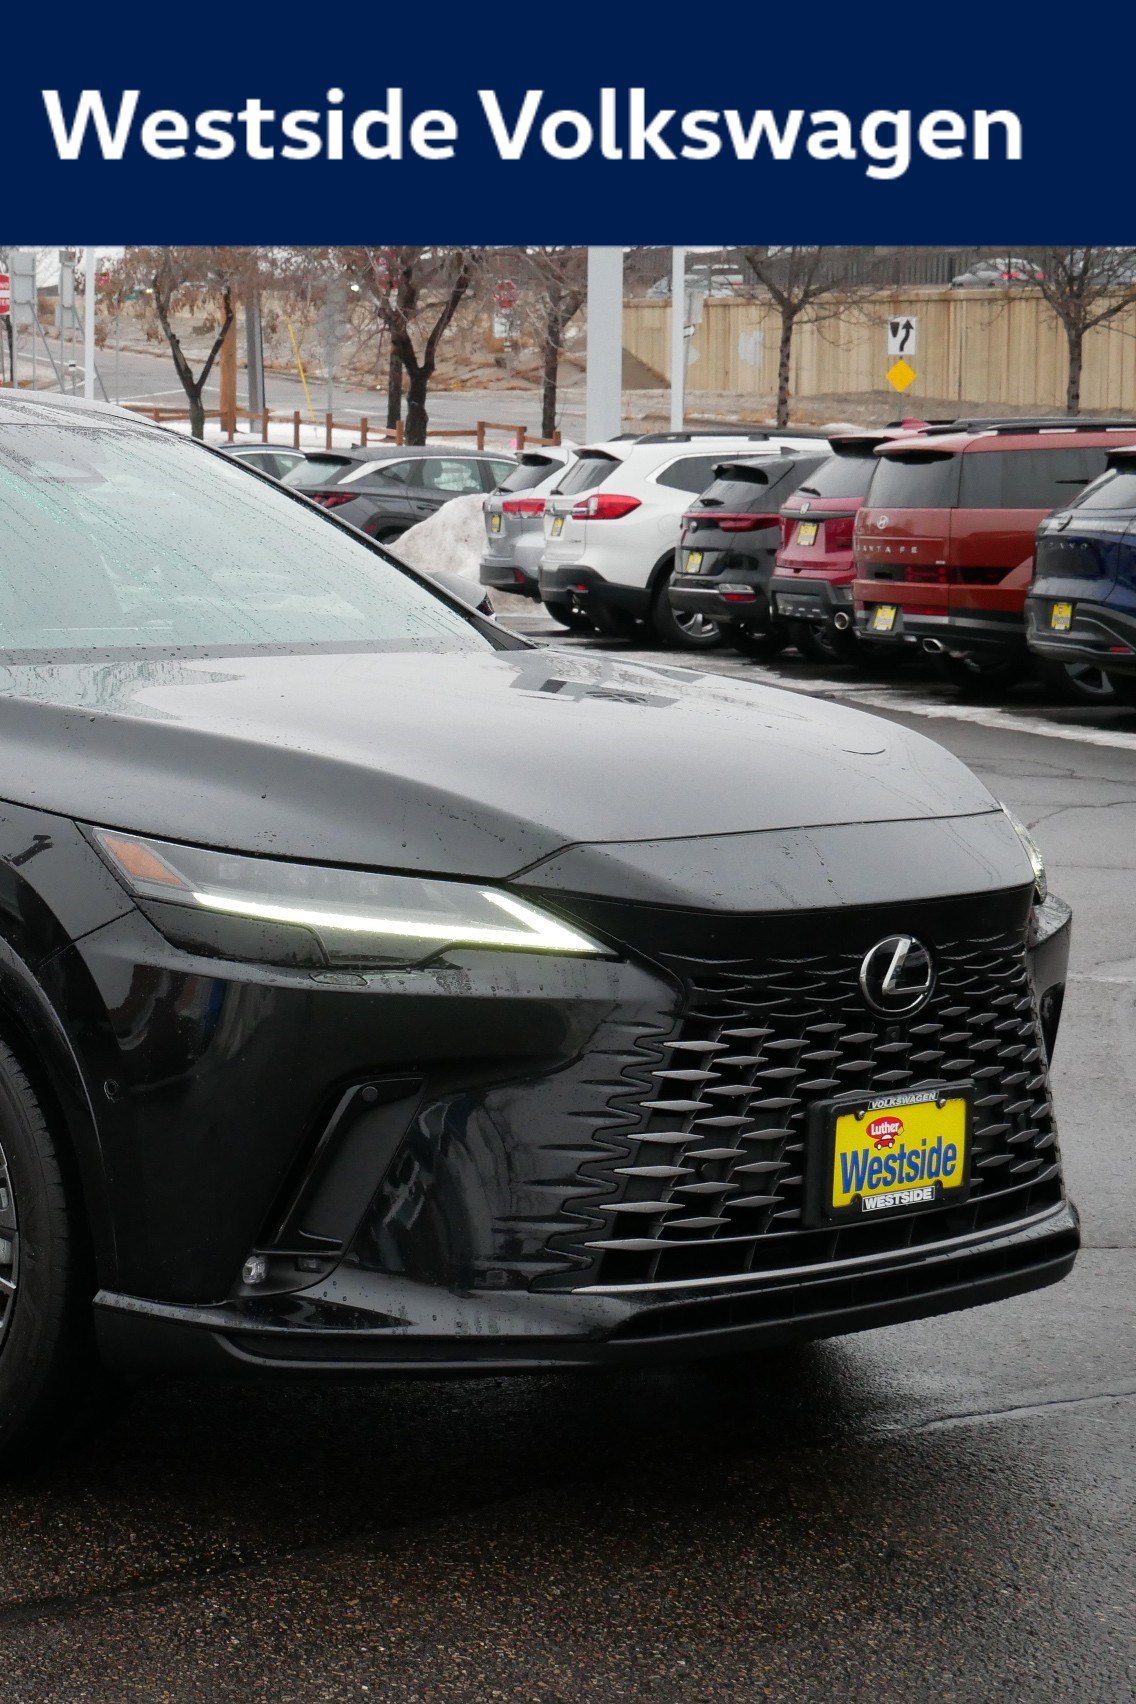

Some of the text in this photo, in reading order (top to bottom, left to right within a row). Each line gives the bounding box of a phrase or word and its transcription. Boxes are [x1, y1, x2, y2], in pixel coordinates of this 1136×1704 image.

[871, 1092, 937, 1109] VOLKSWAGEN
[870, 1121, 900, 1136] Luther
[839, 1135, 957, 1194] Westside
[863, 1187, 933, 1209] WESTSIDE
